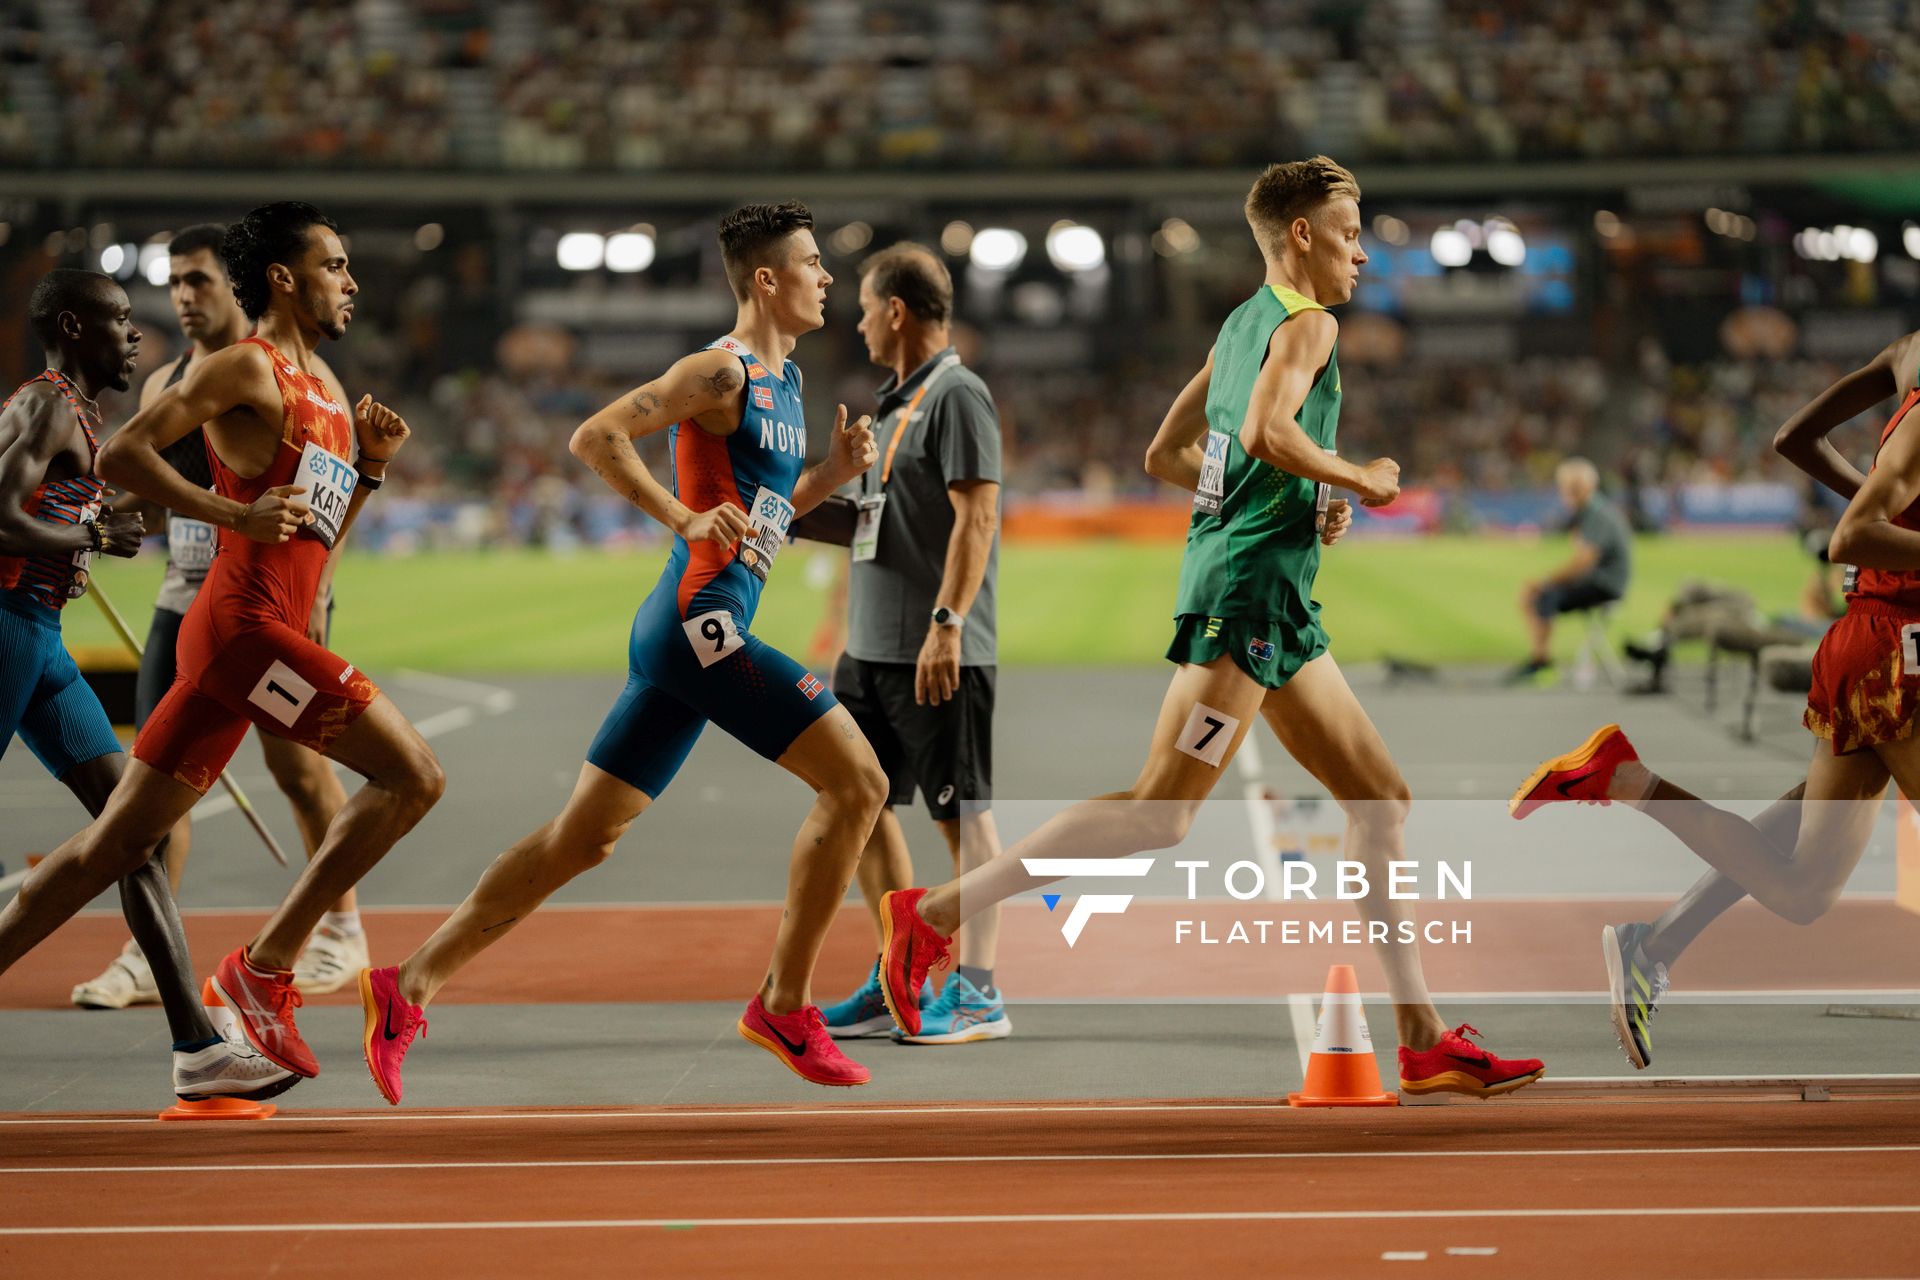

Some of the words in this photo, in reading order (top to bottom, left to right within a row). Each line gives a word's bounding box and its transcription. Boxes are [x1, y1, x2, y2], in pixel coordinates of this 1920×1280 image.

[701, 618, 725, 653] 9
[266, 680, 300, 707] 1
[1194, 716, 1225, 751] 7
